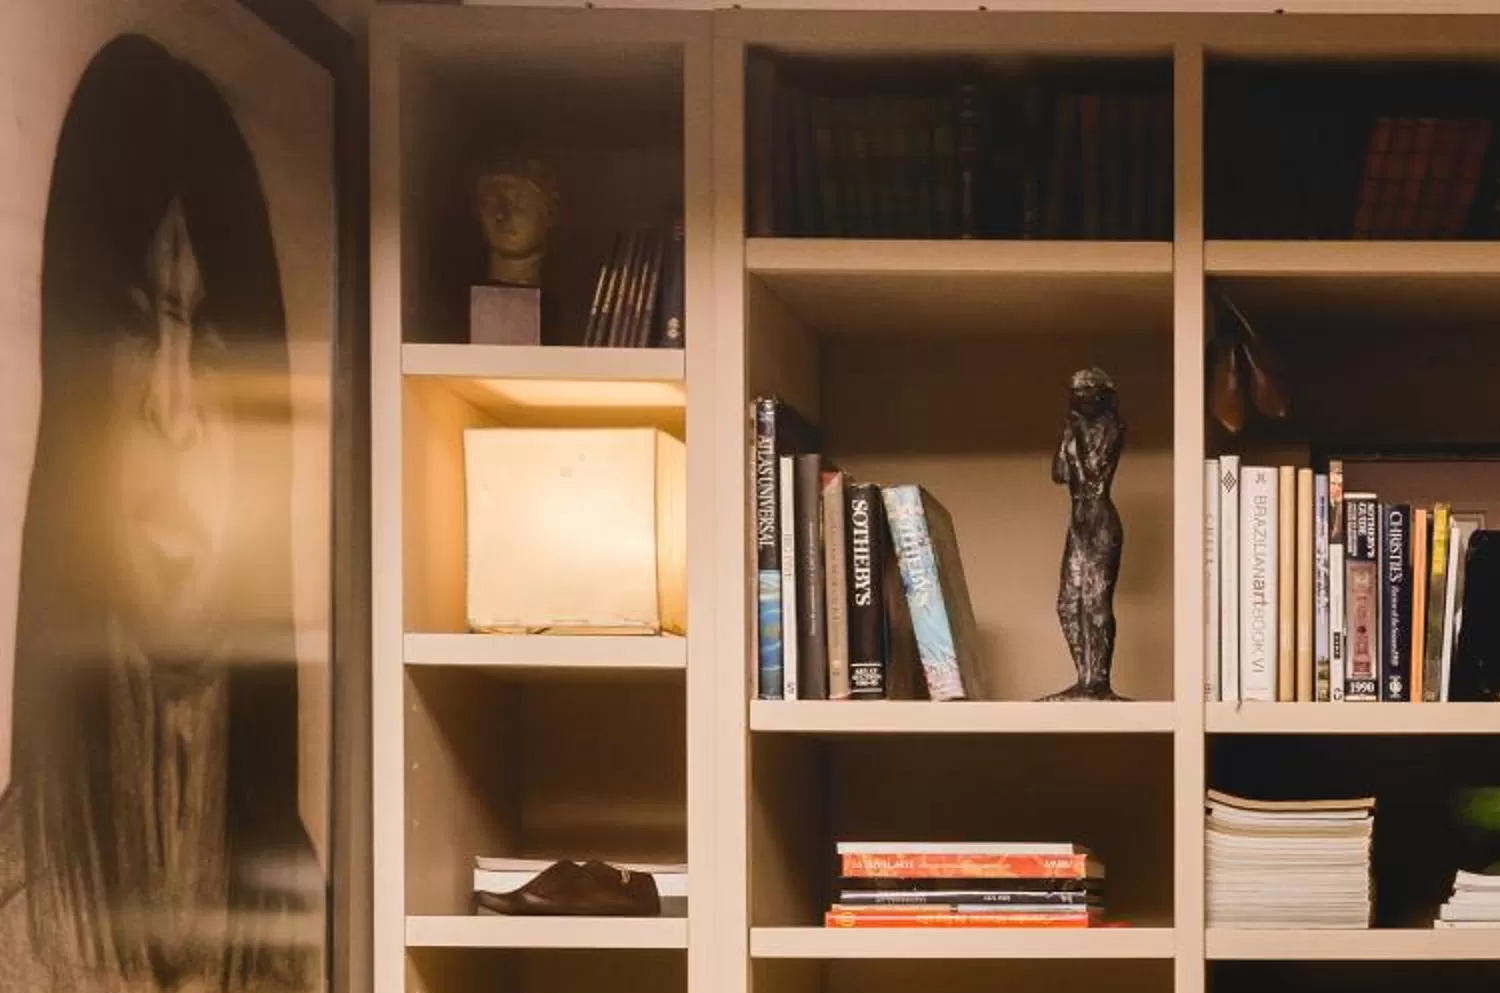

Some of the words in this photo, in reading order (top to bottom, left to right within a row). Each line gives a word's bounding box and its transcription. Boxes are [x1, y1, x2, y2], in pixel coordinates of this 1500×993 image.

[756, 436, 775, 475] ATLAS
[757, 476, 777, 548] UNIVERSAL
[1388, 510, 1404, 583] CHRISTIE'S
[850, 499, 872, 607] SOTHEBY'S
[1349, 681, 1375, 695] 1990
